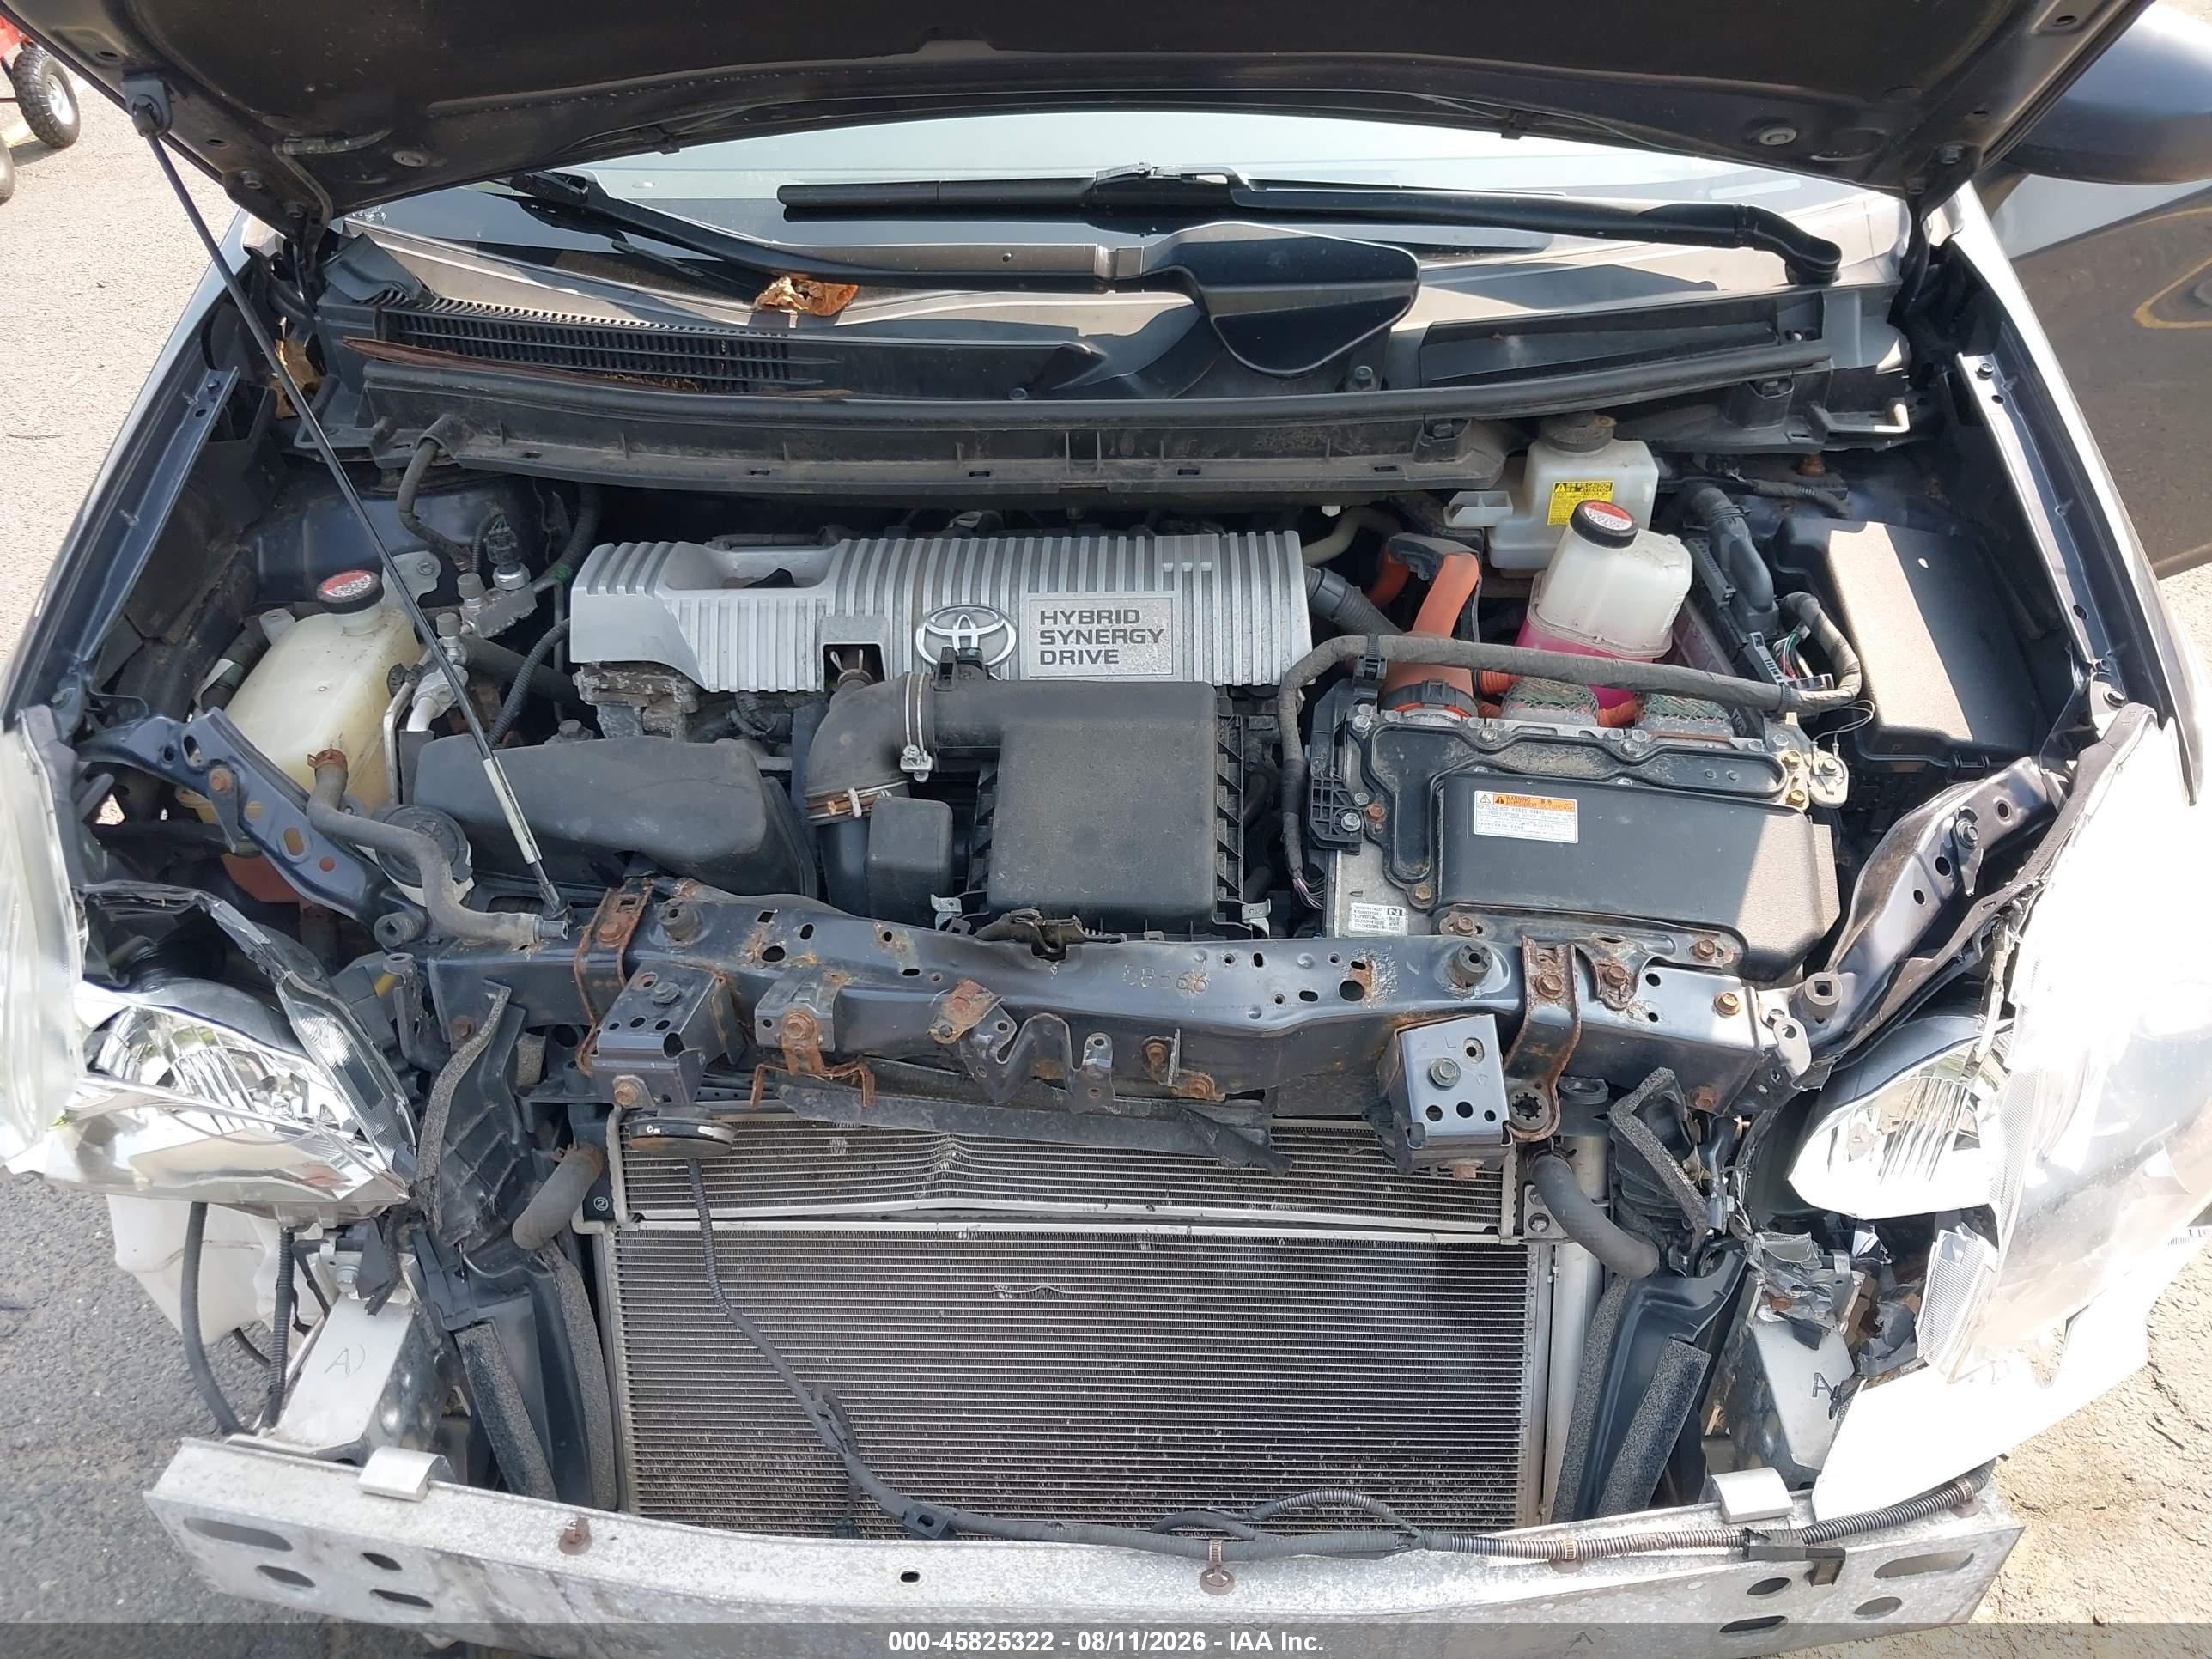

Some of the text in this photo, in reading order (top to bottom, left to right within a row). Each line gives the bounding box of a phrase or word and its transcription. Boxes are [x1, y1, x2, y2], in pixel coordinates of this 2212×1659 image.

[1040, 609, 1140, 625] HYBRID
[1039, 629, 1164, 646] SYNERGY
[1040, 649, 1119, 665] DRIVE
[1812, 1372, 1834, 1398] A
